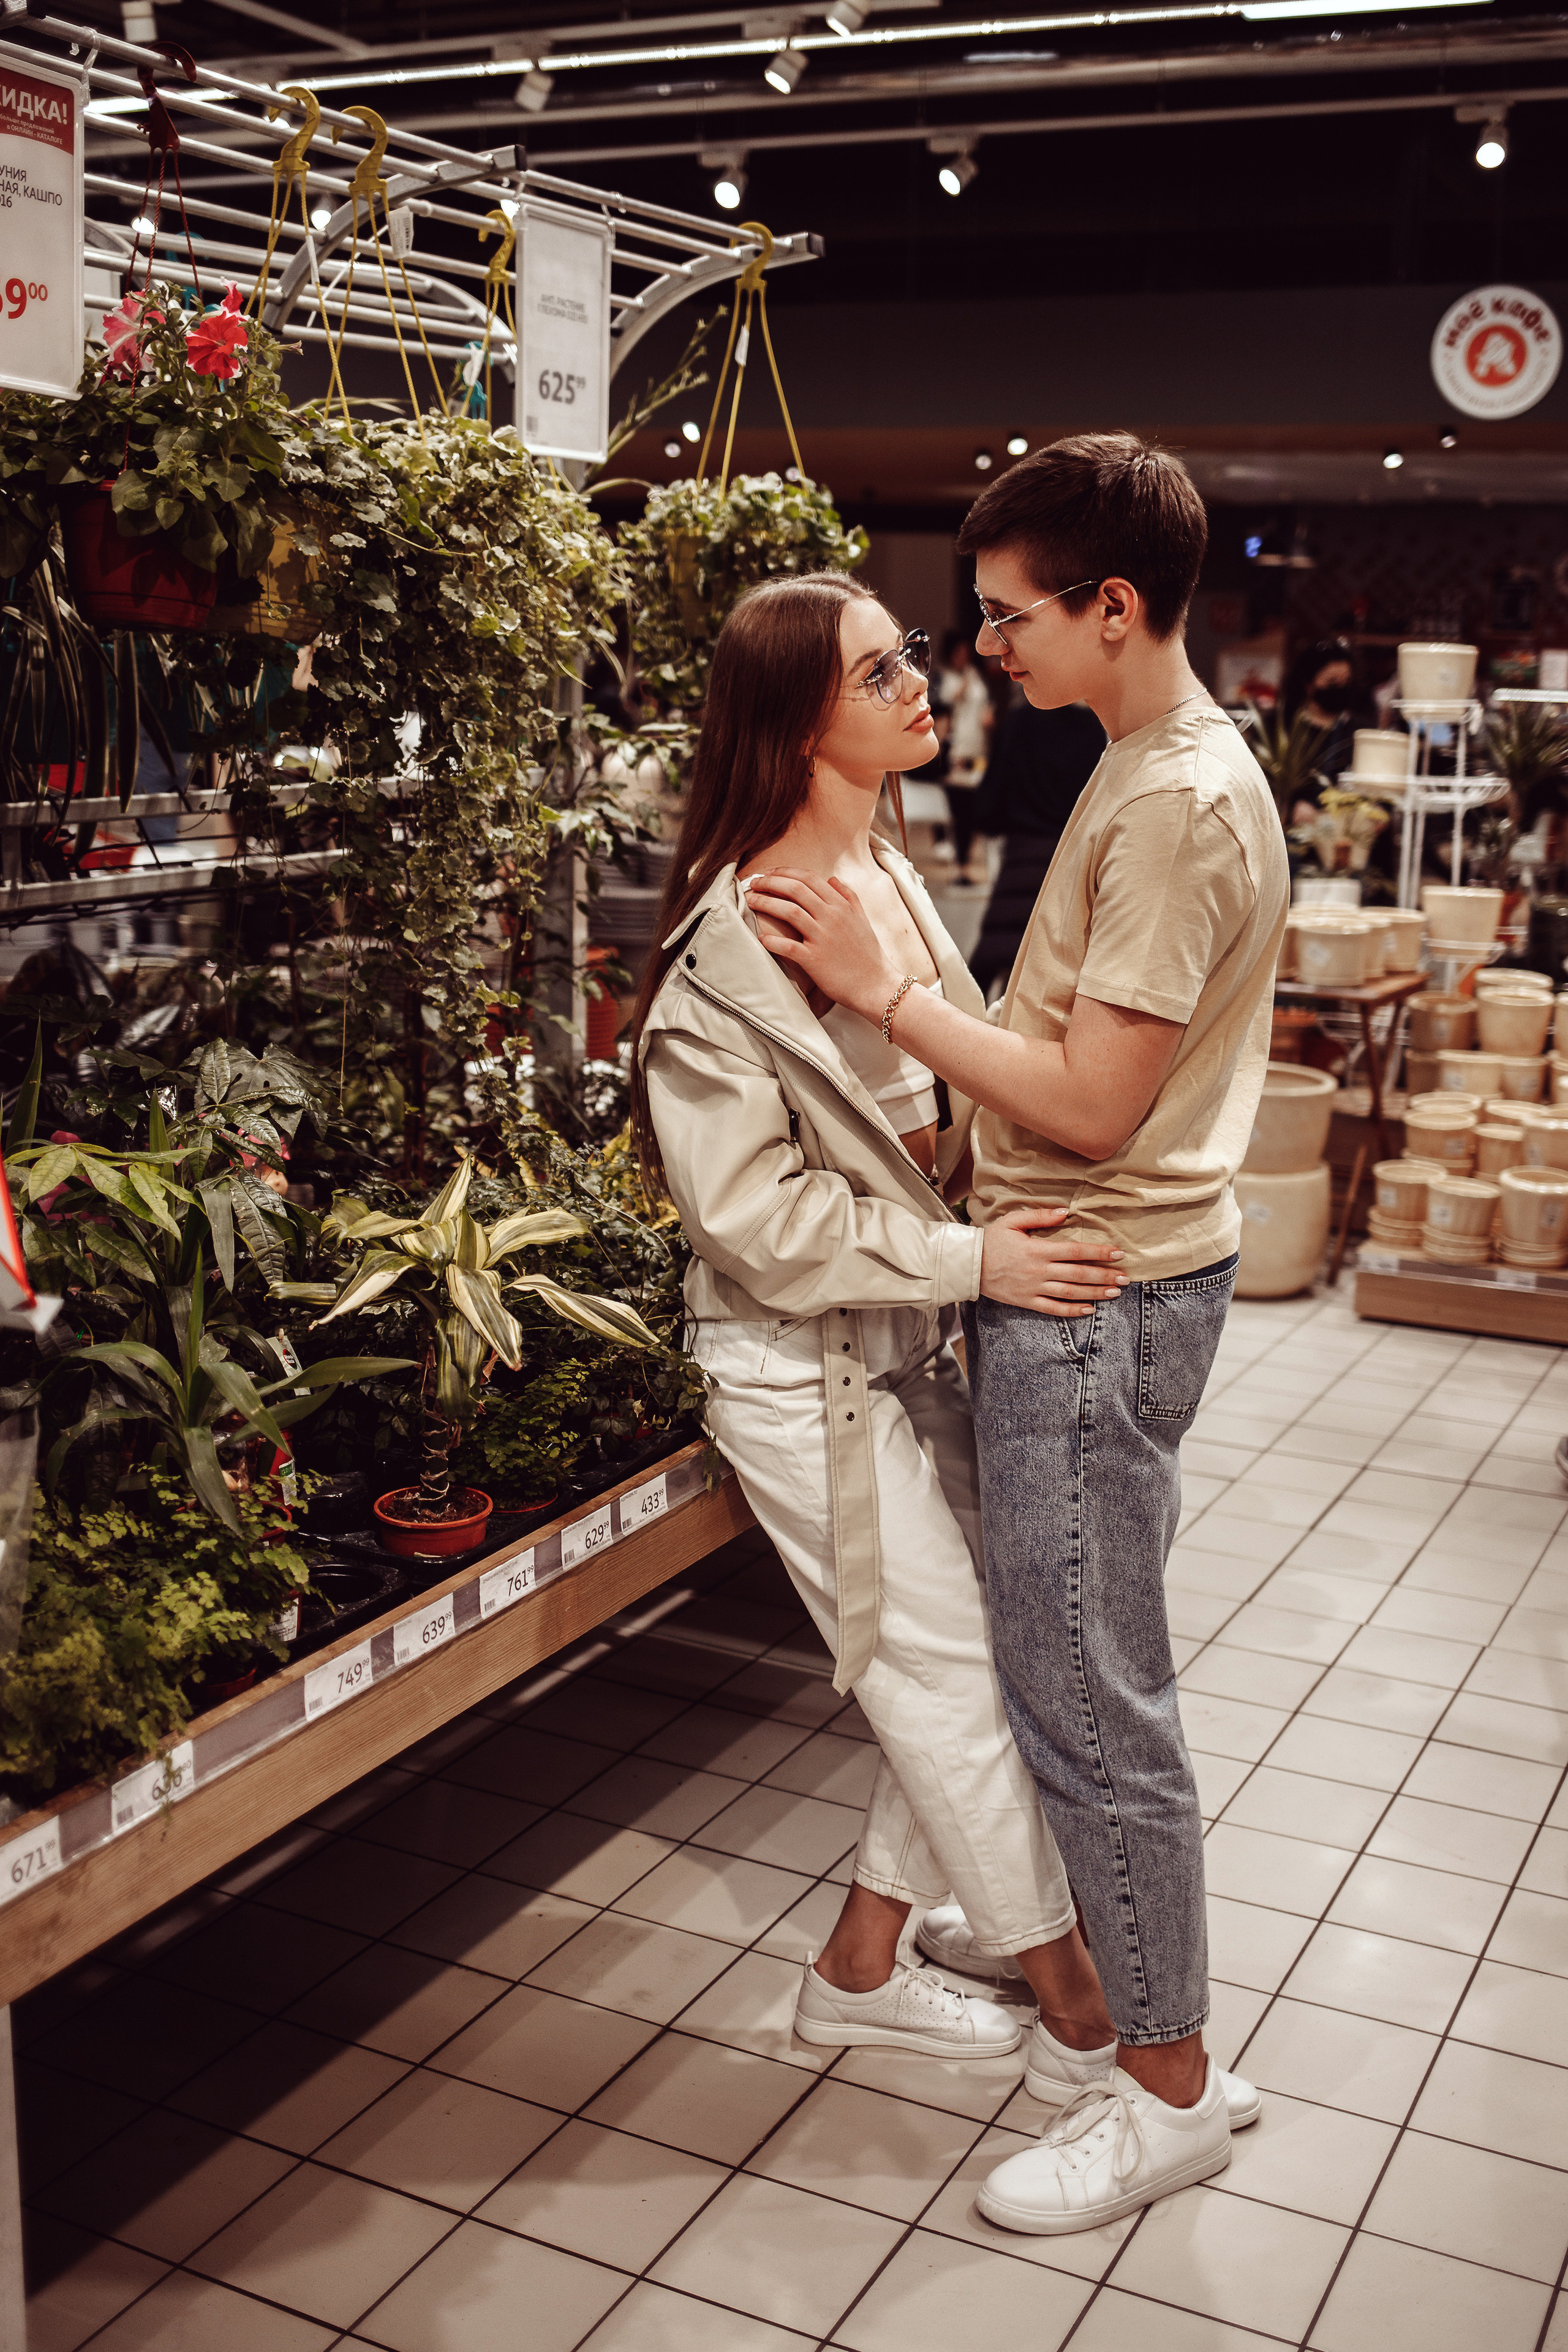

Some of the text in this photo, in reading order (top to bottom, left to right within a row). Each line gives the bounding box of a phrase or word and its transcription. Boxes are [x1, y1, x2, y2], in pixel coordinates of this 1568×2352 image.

[0, 84, 67, 125] ИДКА!
[37, 132, 63, 145] КАТАЛОГЕ
[0, 194, 12, 208] 16
[23, 185, 62, 206] КАШПО
